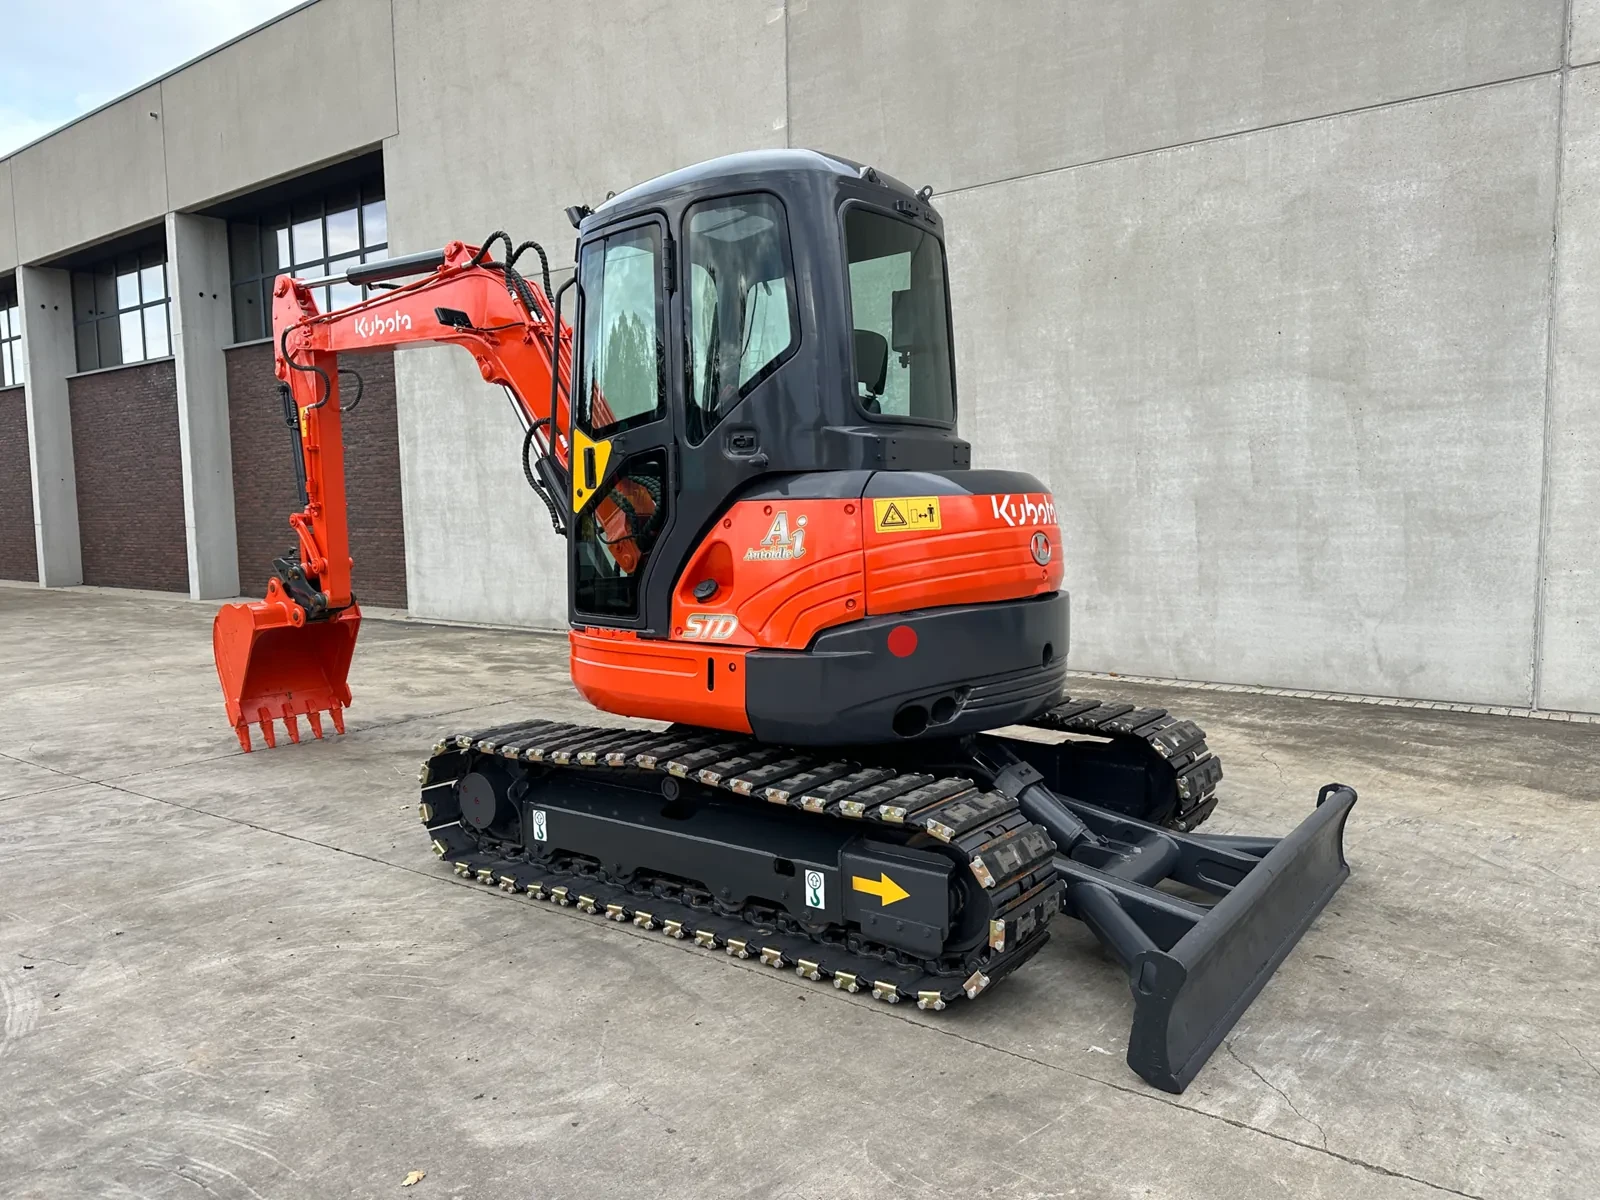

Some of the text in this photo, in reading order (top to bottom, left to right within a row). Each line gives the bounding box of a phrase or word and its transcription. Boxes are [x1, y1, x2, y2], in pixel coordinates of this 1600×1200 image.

[354, 310, 412, 338] Kubota
[990, 494, 1058, 526] Kubota
[683, 613, 738, 639] STD
